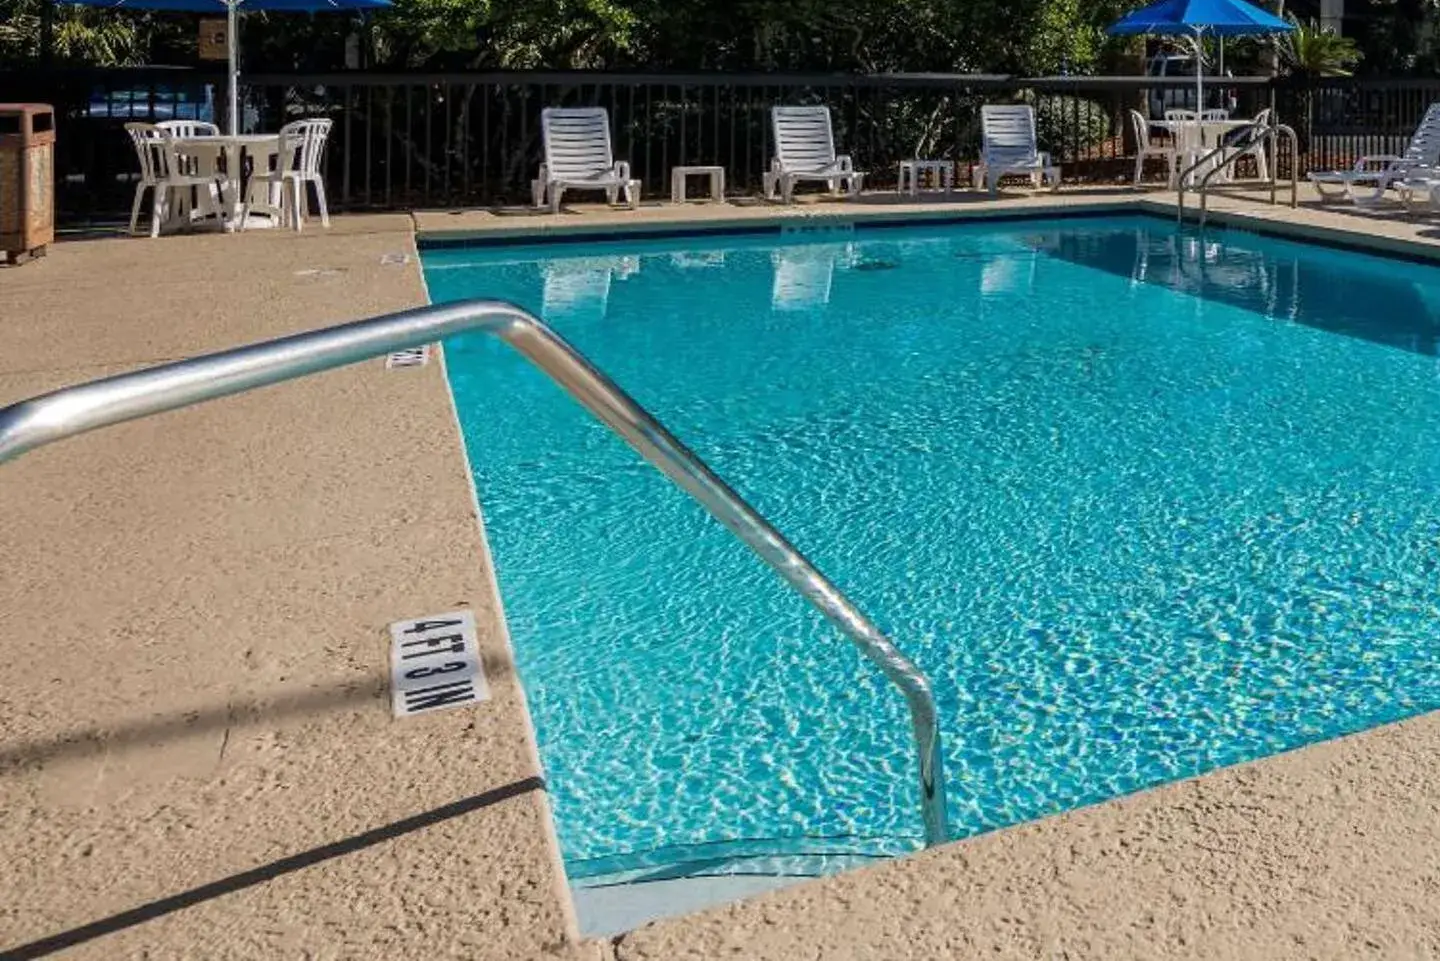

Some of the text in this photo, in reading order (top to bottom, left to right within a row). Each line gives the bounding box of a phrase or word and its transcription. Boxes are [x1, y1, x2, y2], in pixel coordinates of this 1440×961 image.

[401, 619, 475, 712] 4 FT 3 IN
